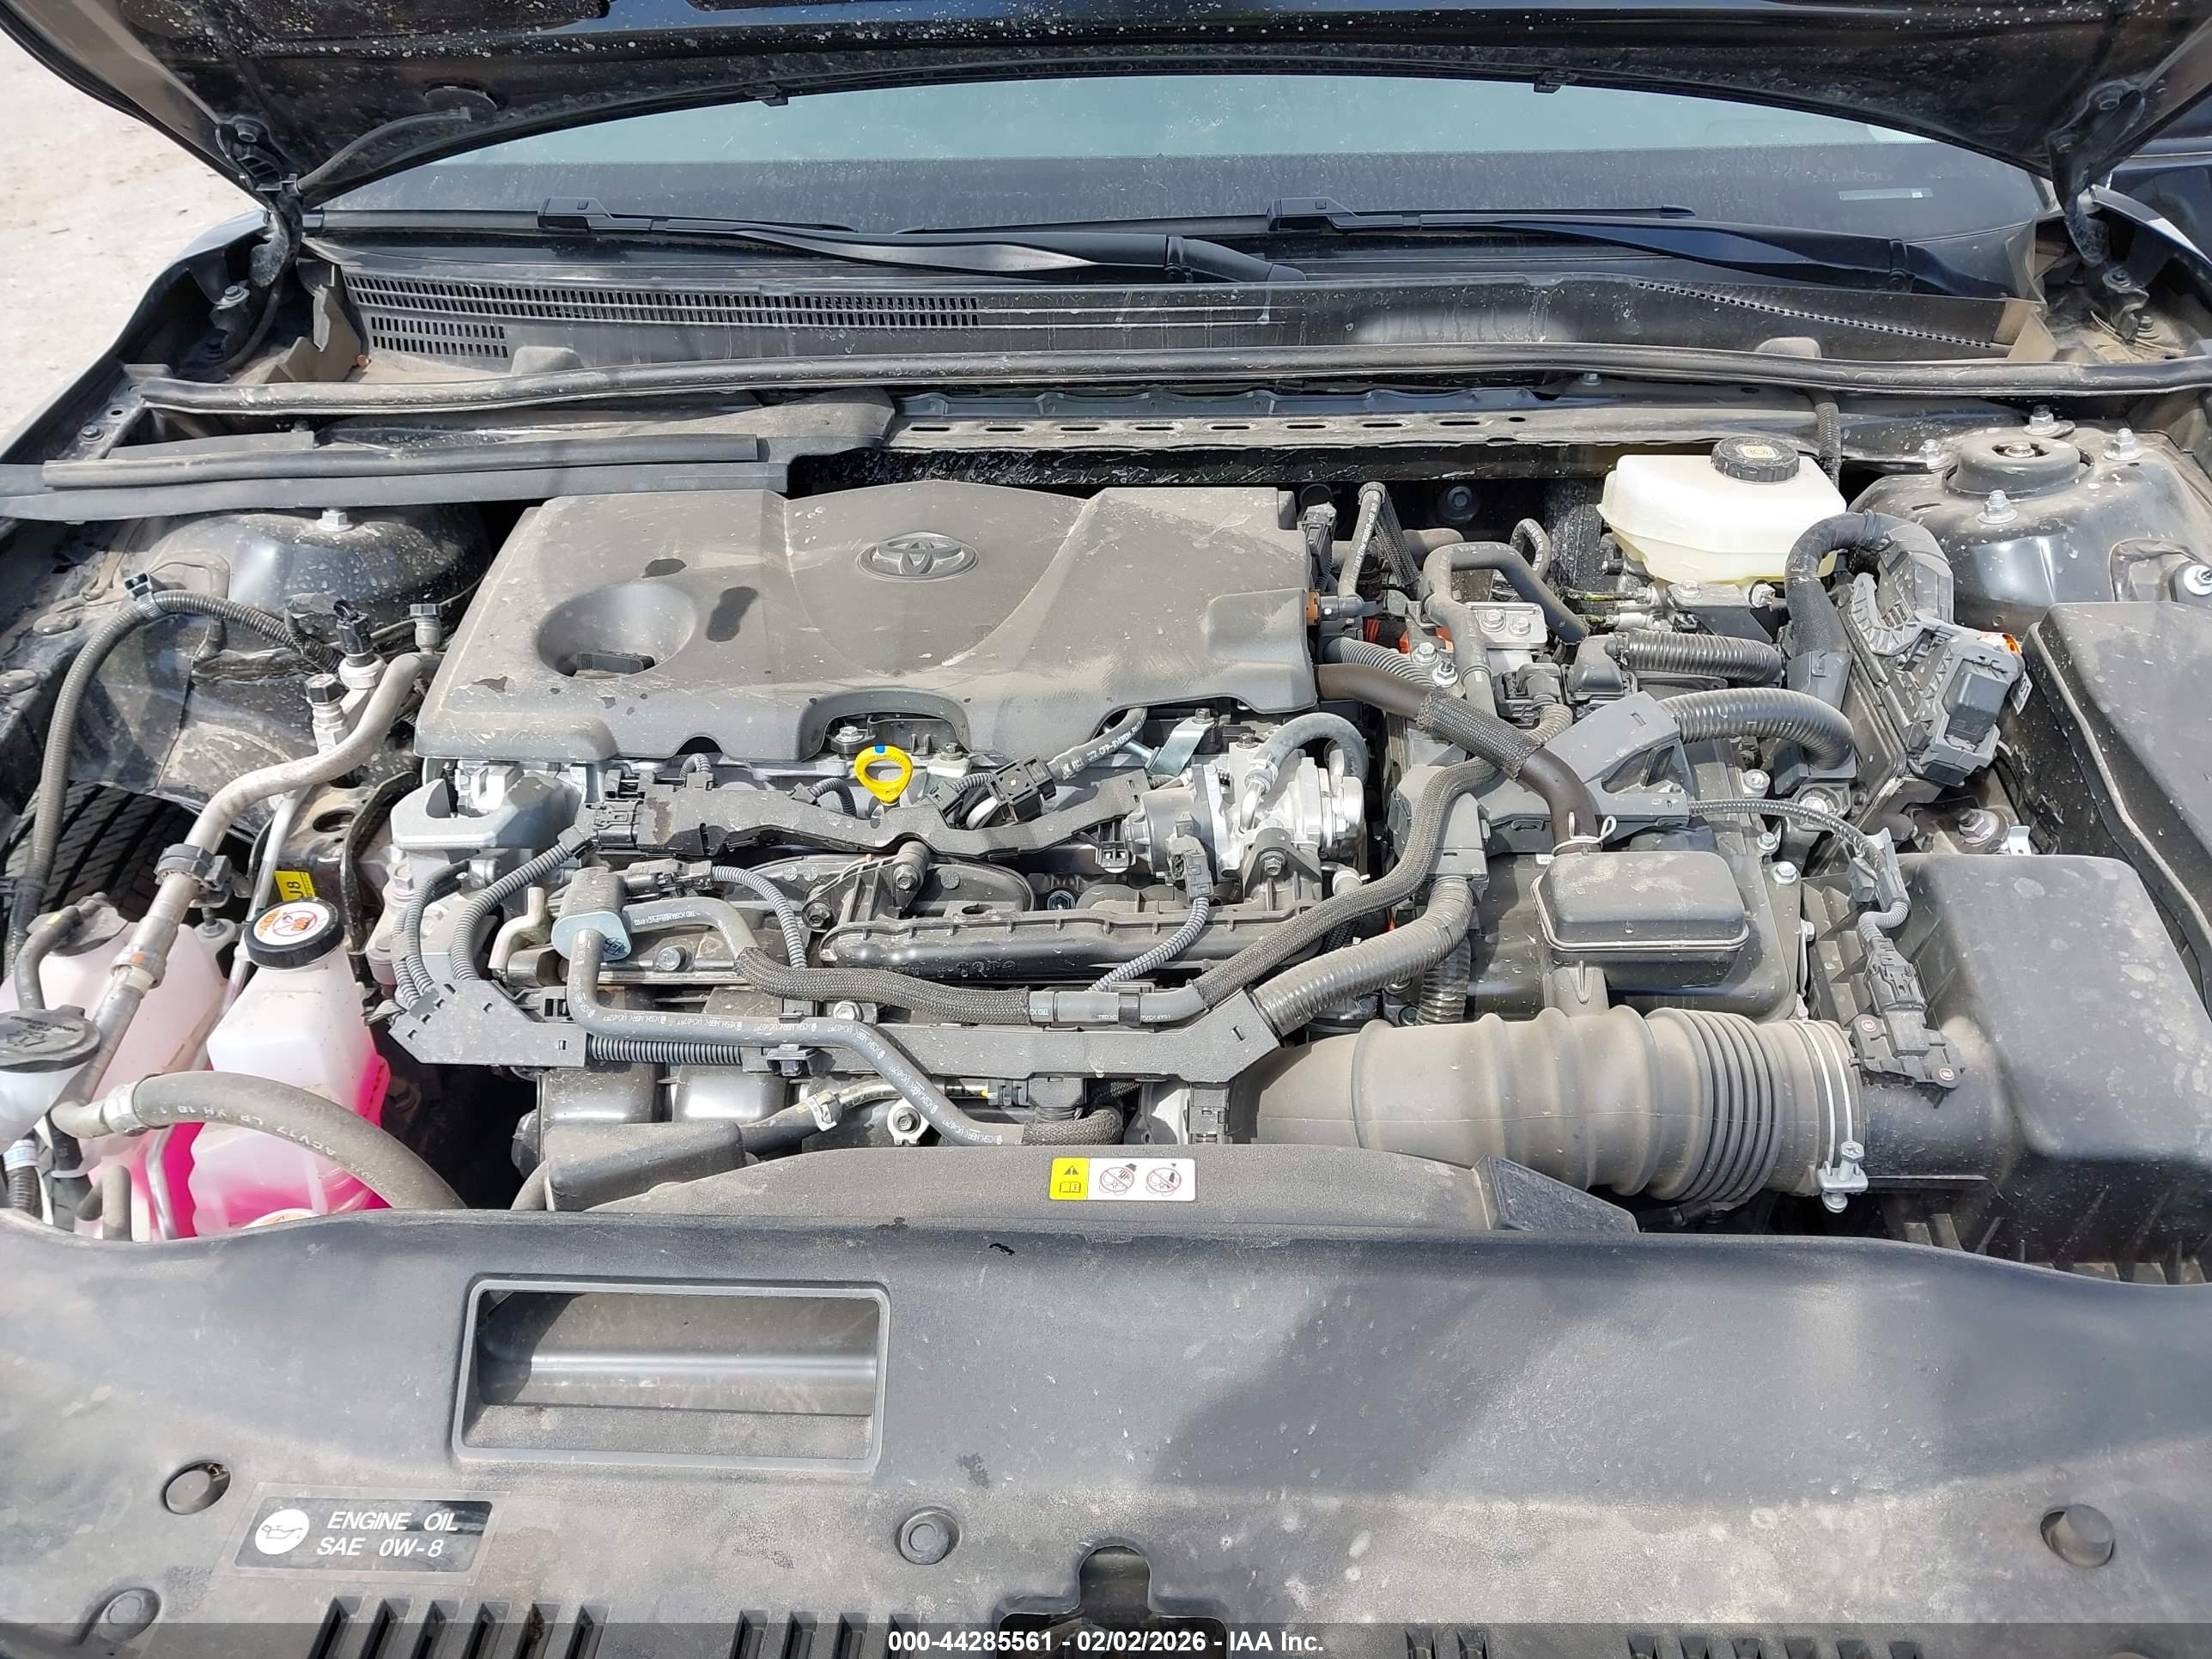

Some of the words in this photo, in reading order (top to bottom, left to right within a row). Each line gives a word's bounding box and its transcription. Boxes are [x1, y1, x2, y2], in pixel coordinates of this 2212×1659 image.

[327, 1511, 412, 1530] ENGINE
[423, 1512, 458, 1531] OIL
[317, 1537, 366, 1556] SAE
[379, 1538, 444, 1558] 0W-8
